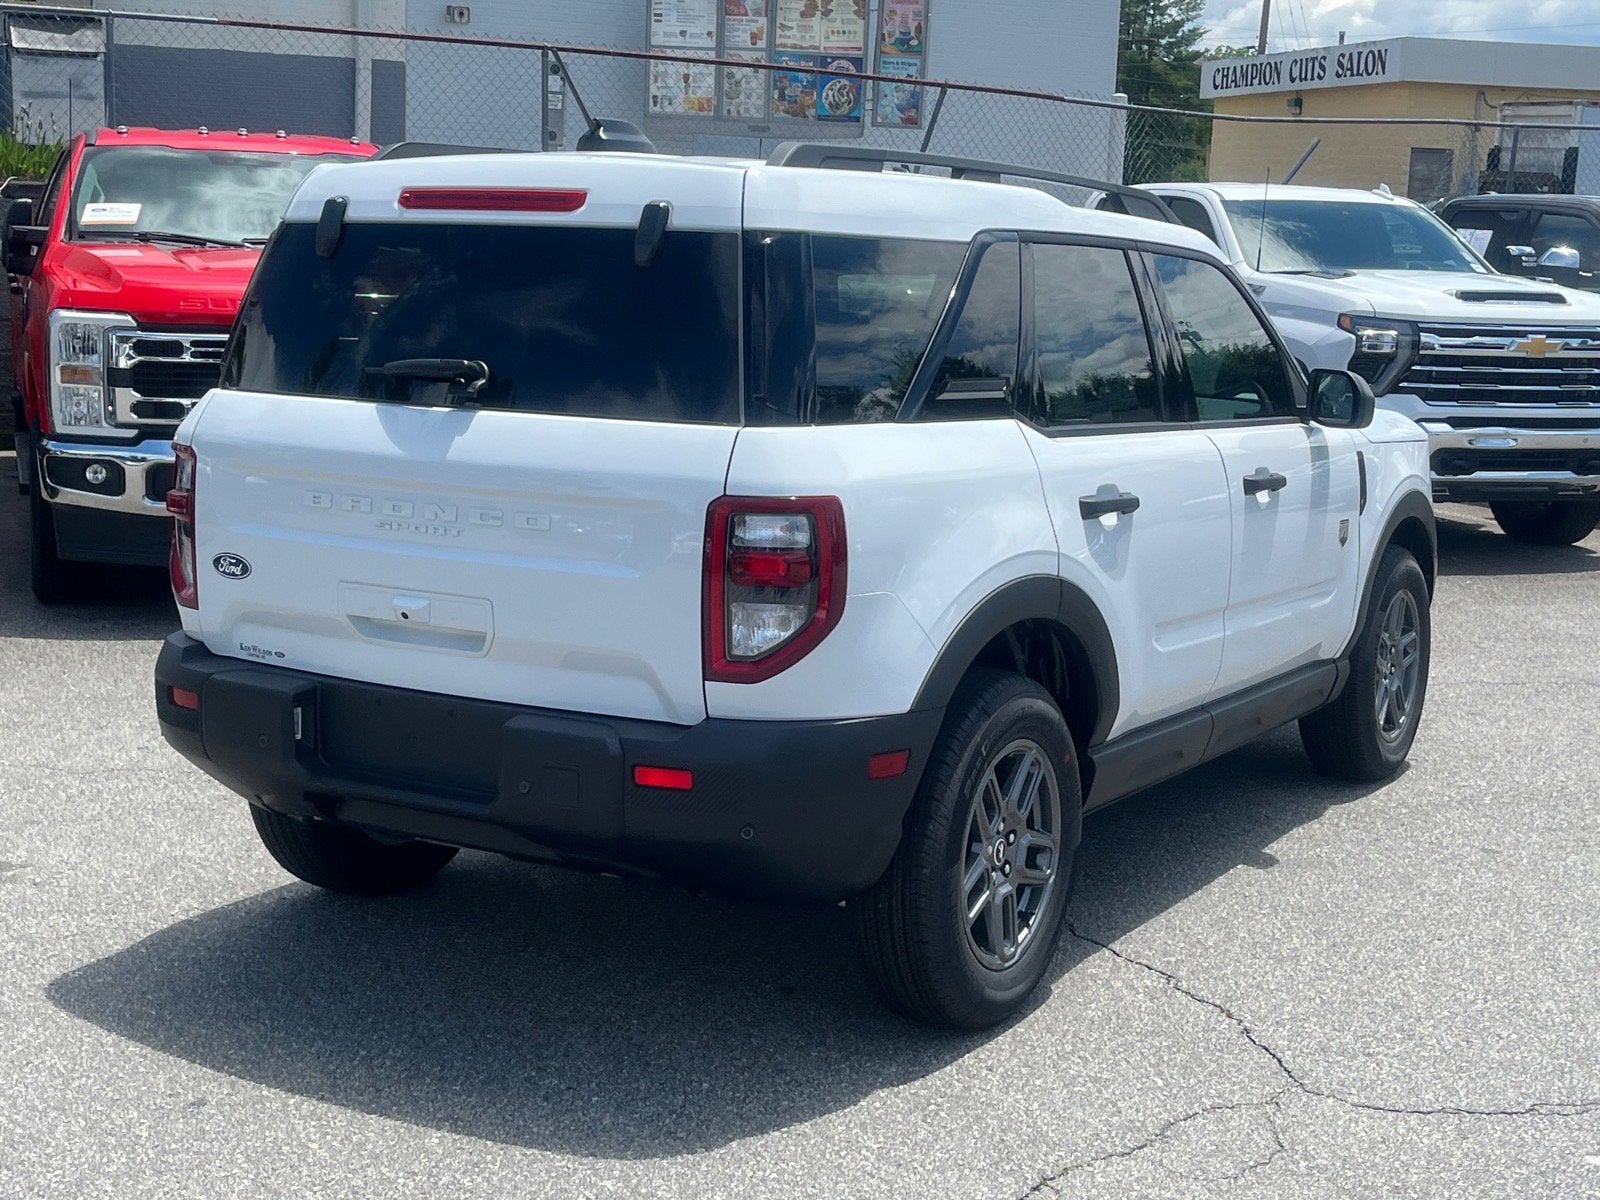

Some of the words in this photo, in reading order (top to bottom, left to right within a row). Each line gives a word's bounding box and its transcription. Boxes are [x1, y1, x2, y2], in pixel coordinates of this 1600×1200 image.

[1212, 61, 1283, 90] CHAMPION
[1289, 56, 1327, 83] CUTS
[1335, 49, 1388, 78] SALON
[303, 489, 551, 532] BRONCO
[375, 520, 465, 538] SPORT
[217, 555, 246, 577] Ford
